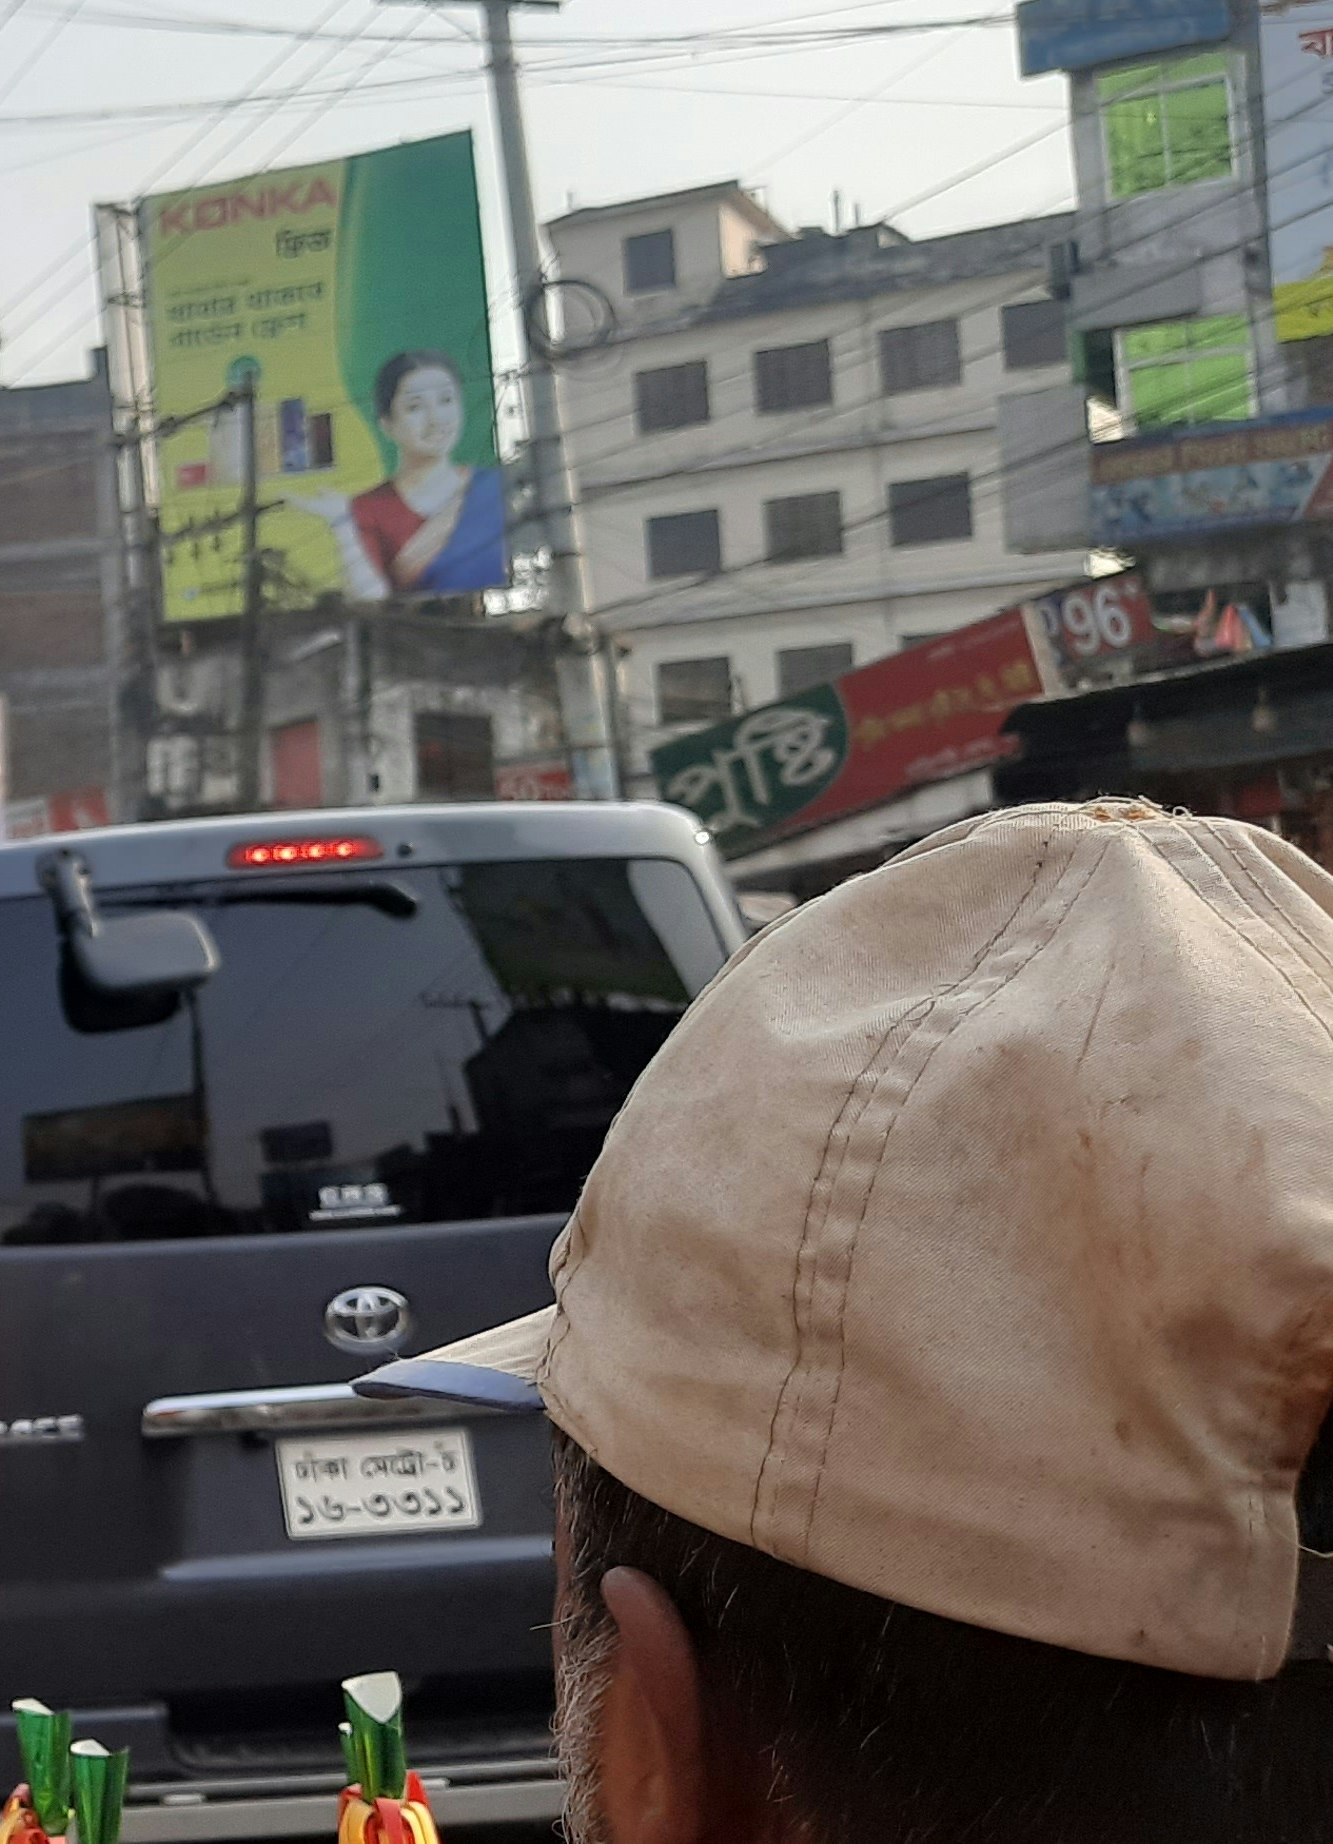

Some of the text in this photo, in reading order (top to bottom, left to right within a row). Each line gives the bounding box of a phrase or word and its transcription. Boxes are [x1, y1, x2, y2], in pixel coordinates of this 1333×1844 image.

[159, 178, 336, 236] KONKA
[668, 708, 834, 832] পুষ্টি
[294, 1486, 465, 1525] ১৬-৩৩১১
